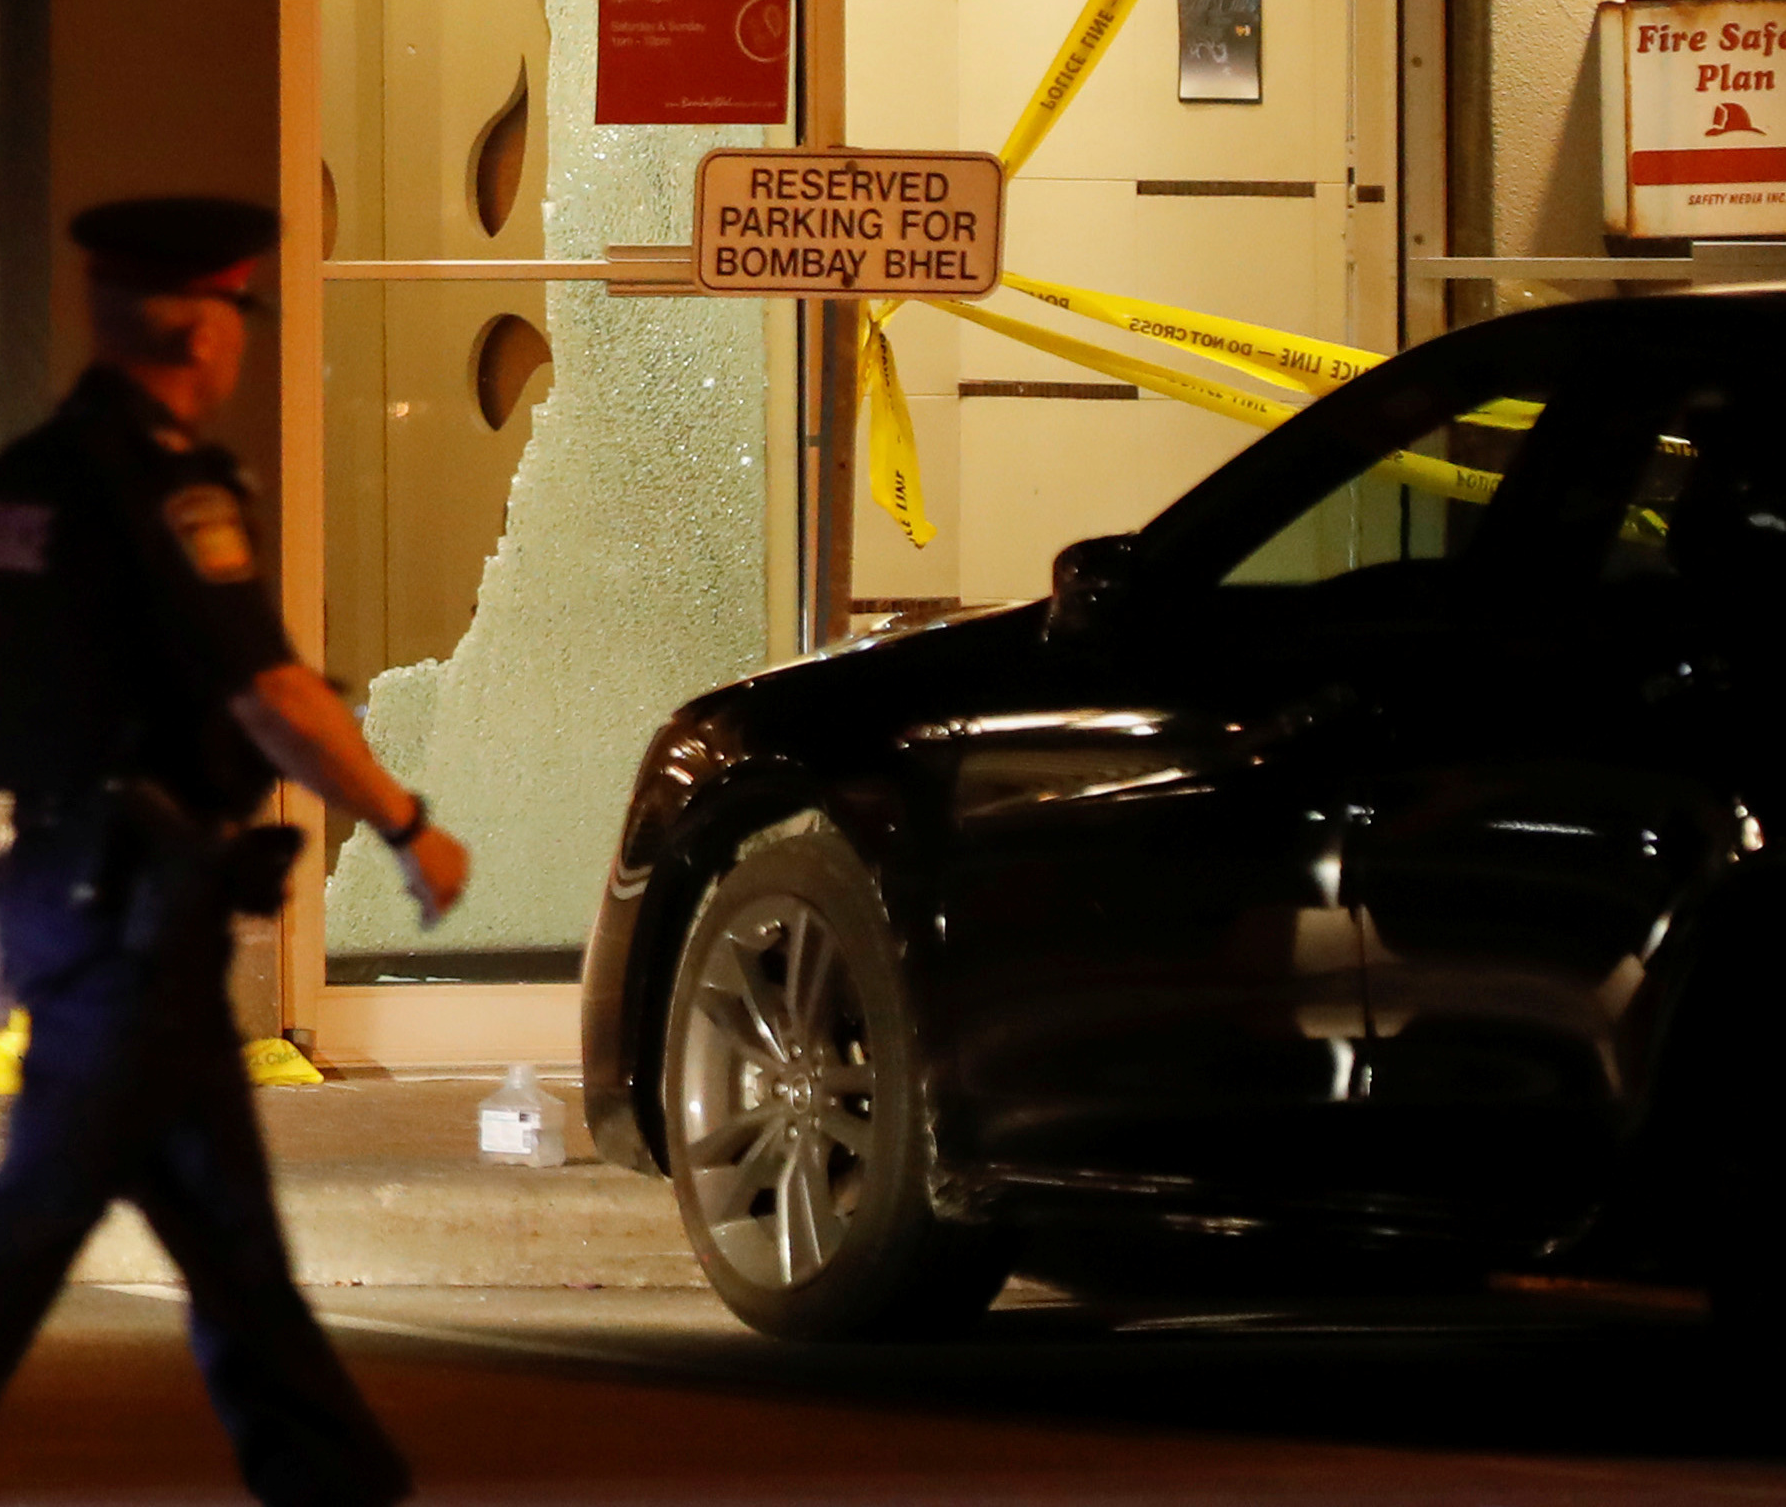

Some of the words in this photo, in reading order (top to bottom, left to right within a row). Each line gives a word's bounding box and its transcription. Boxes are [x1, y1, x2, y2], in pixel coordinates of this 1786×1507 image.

[1636, 24, 1708, 53] Fire
[1696, 63, 1775, 92] Plan
[750, 168, 949, 204] RESERVED
[1688, 193, 1728, 205] SAFETY
[719, 206, 883, 241] PARKING
[900, 210, 977, 243] FOR
[716, 246, 867, 280] BOMBAY
[885, 250, 978, 282] BHEL
